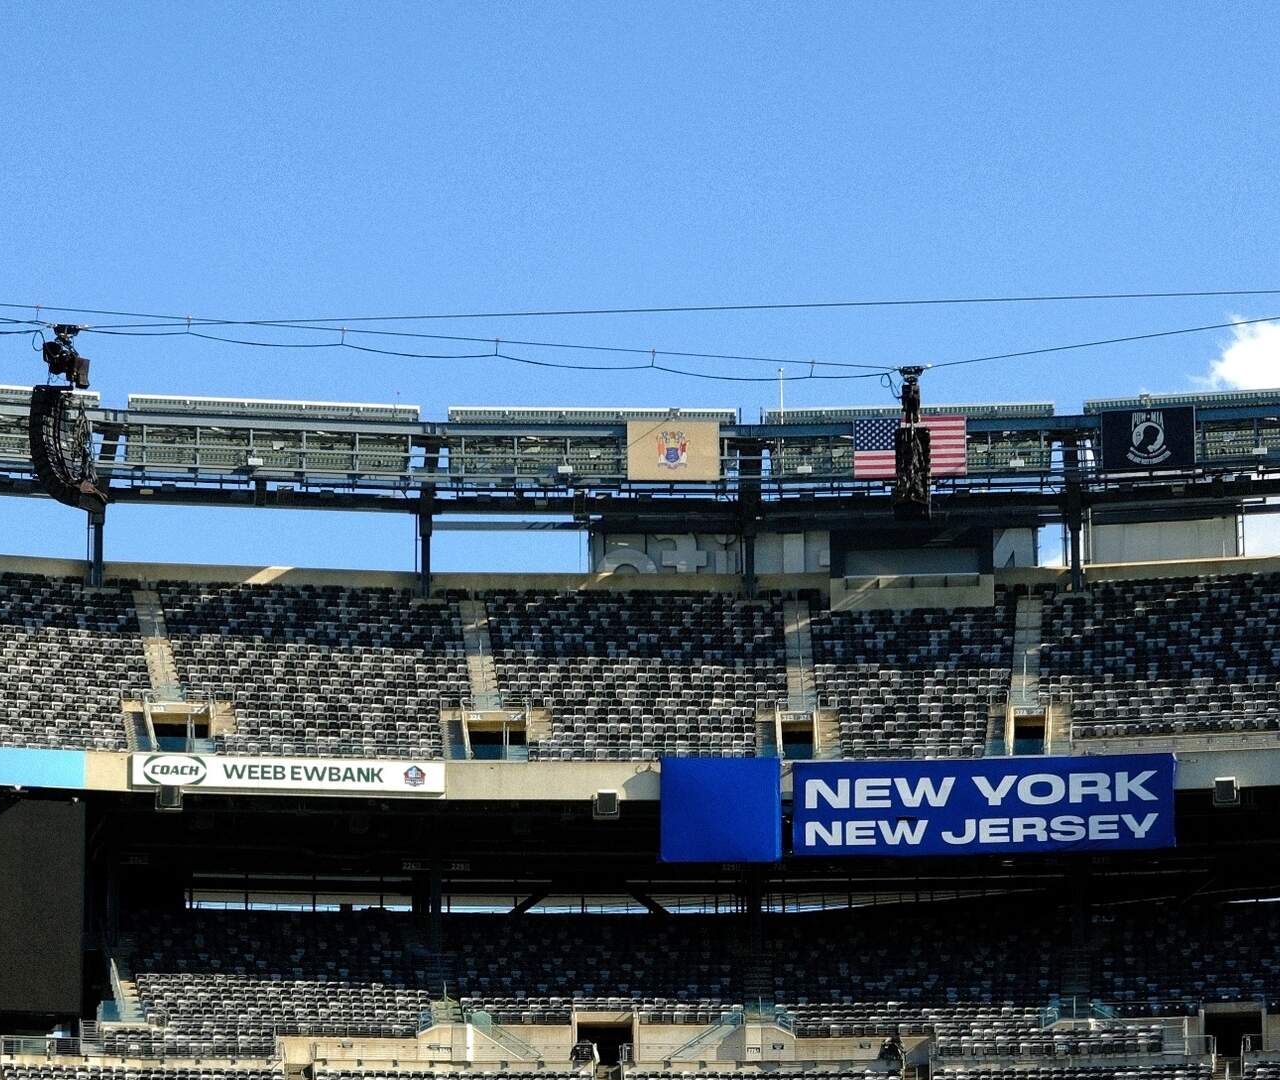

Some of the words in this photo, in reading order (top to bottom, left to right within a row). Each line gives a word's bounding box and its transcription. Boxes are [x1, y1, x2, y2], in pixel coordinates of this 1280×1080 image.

[151, 764, 200, 776] COACH
[223, 763, 286, 780] WEEB
[291, 765, 384, 784] EWBANK
[805, 777, 956, 809] NEW
[971, 770, 1160, 806] YORK
[805, 819, 928, 846] NEW
[941, 812, 1160, 845] JERSEY
